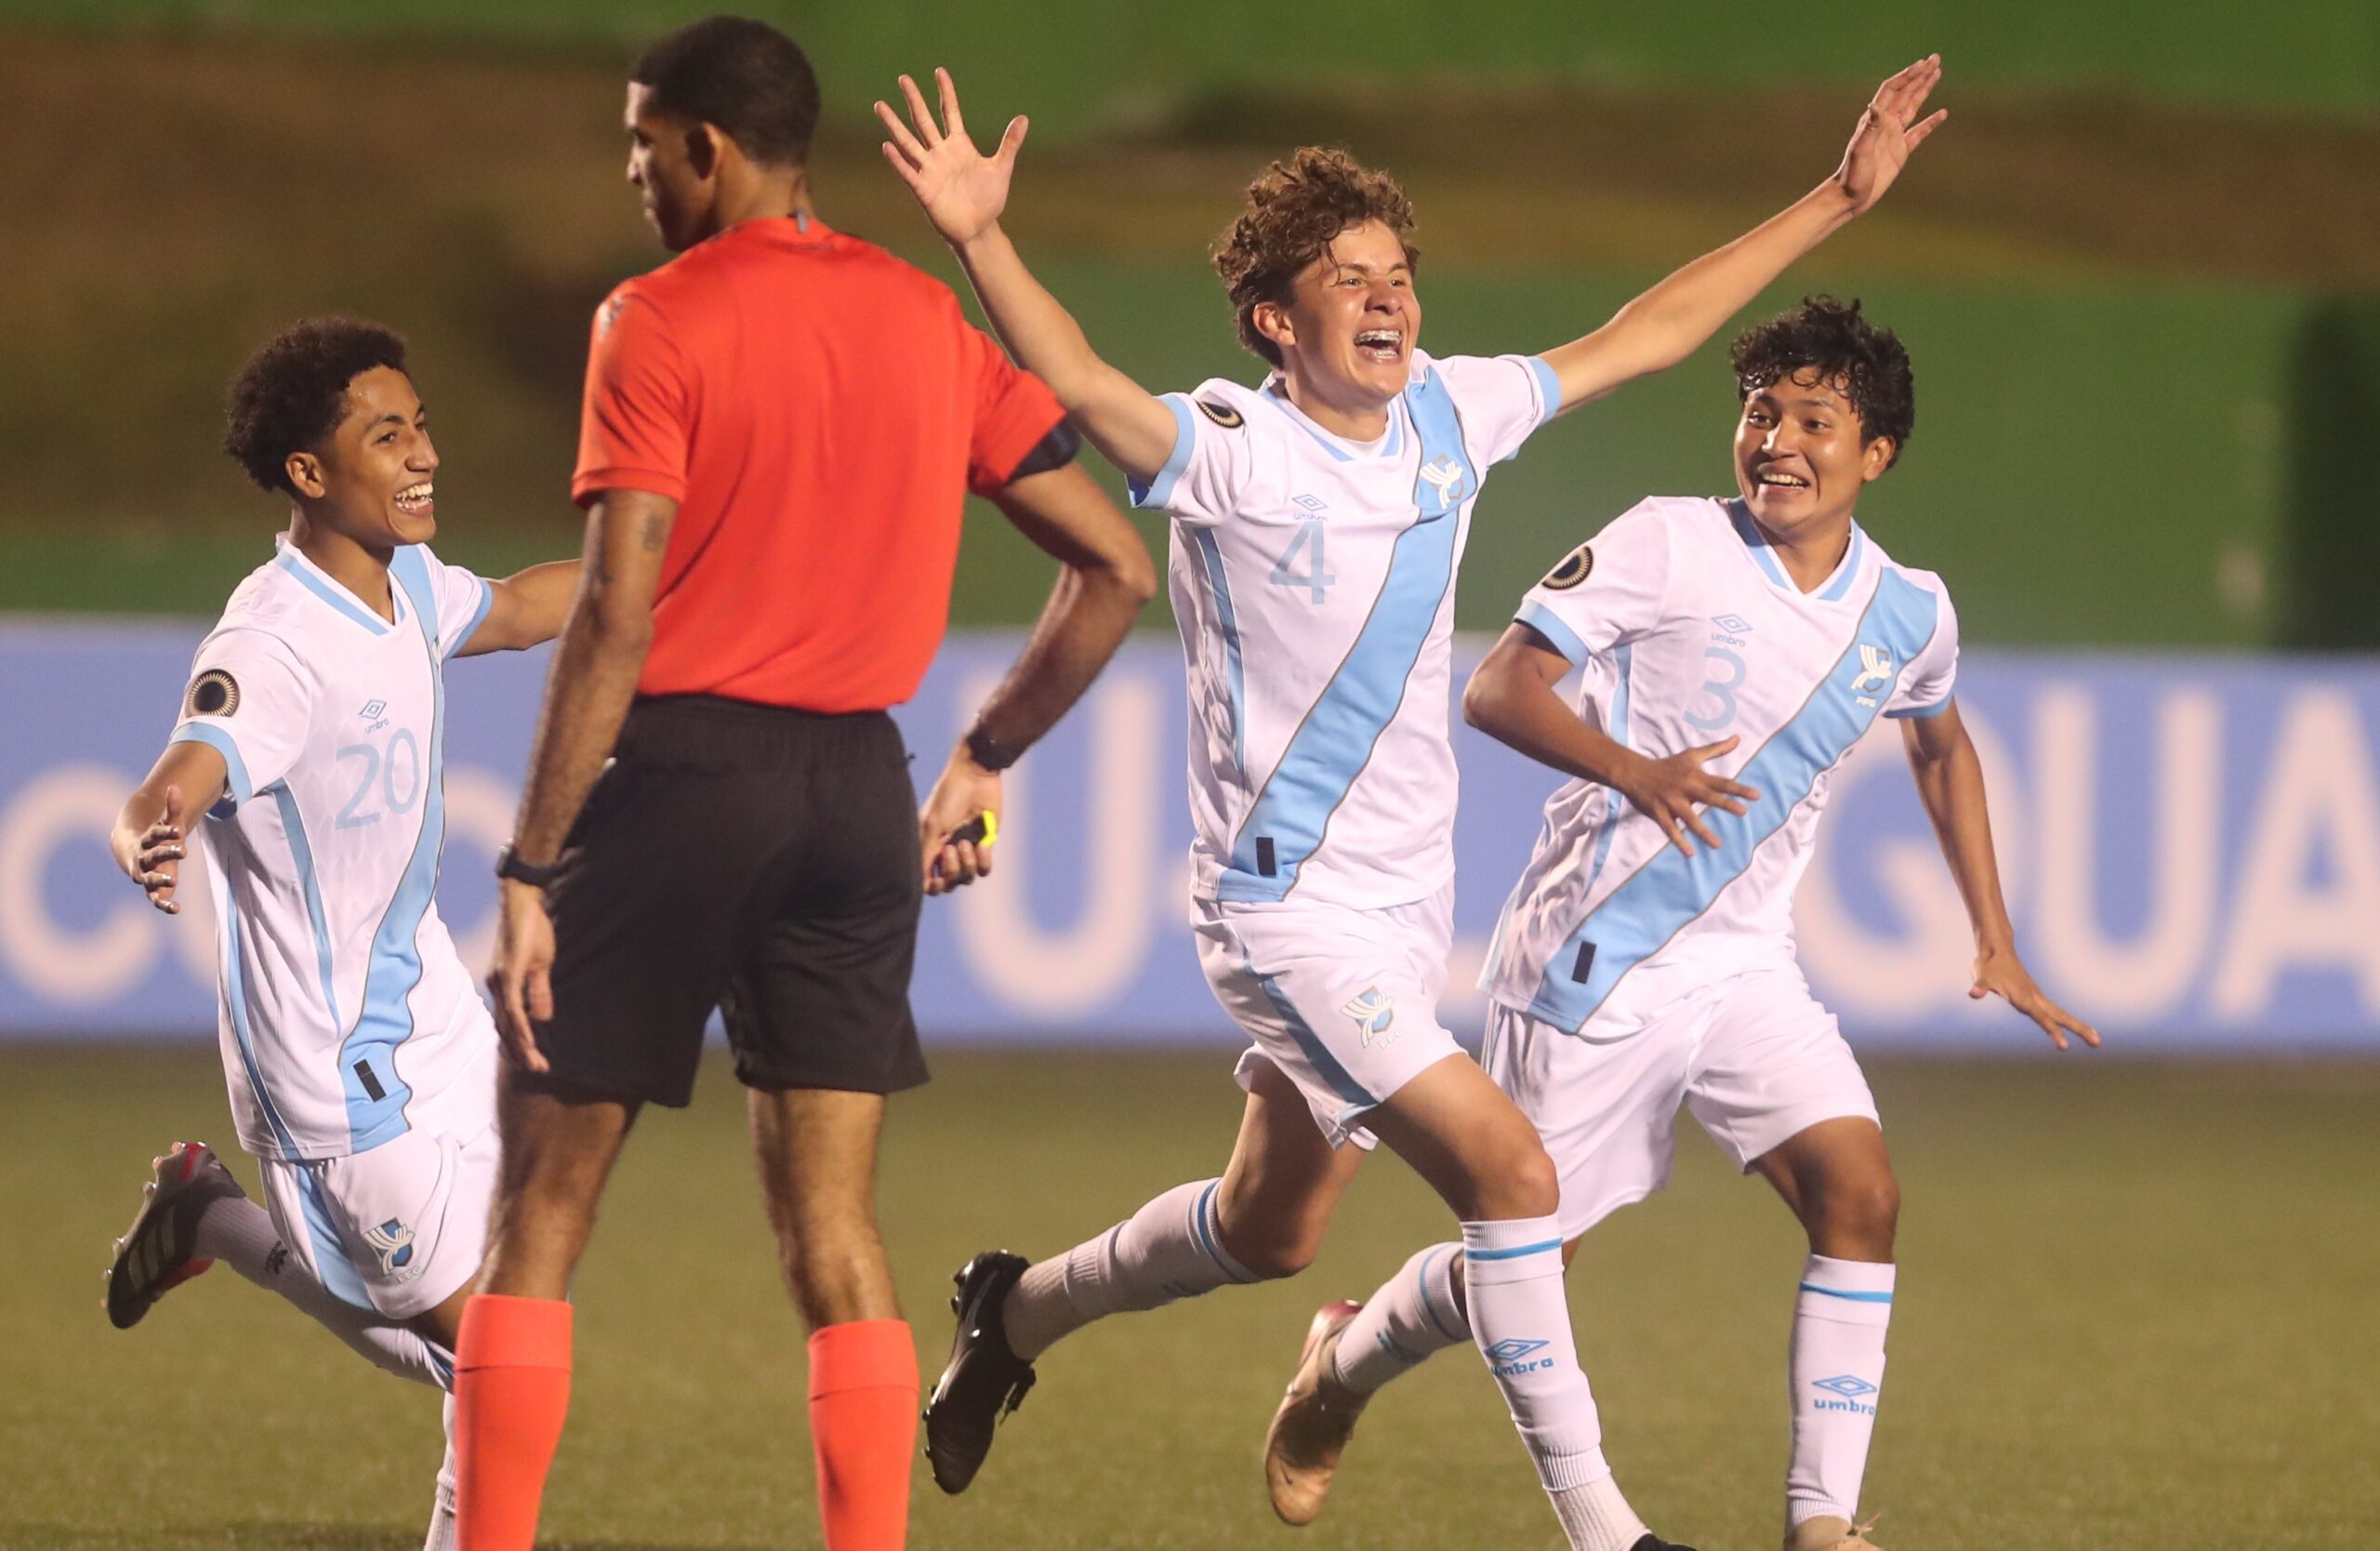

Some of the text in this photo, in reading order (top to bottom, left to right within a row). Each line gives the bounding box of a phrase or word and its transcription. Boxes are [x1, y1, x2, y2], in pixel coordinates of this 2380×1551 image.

[1269, 520, 1336, 605] 4
[1711, 632, 1747, 648] umbro
[1682, 646, 1748, 732] 3
[334, 727, 421, 830] 20
[1813, 1398, 1877, 1415] umbro
